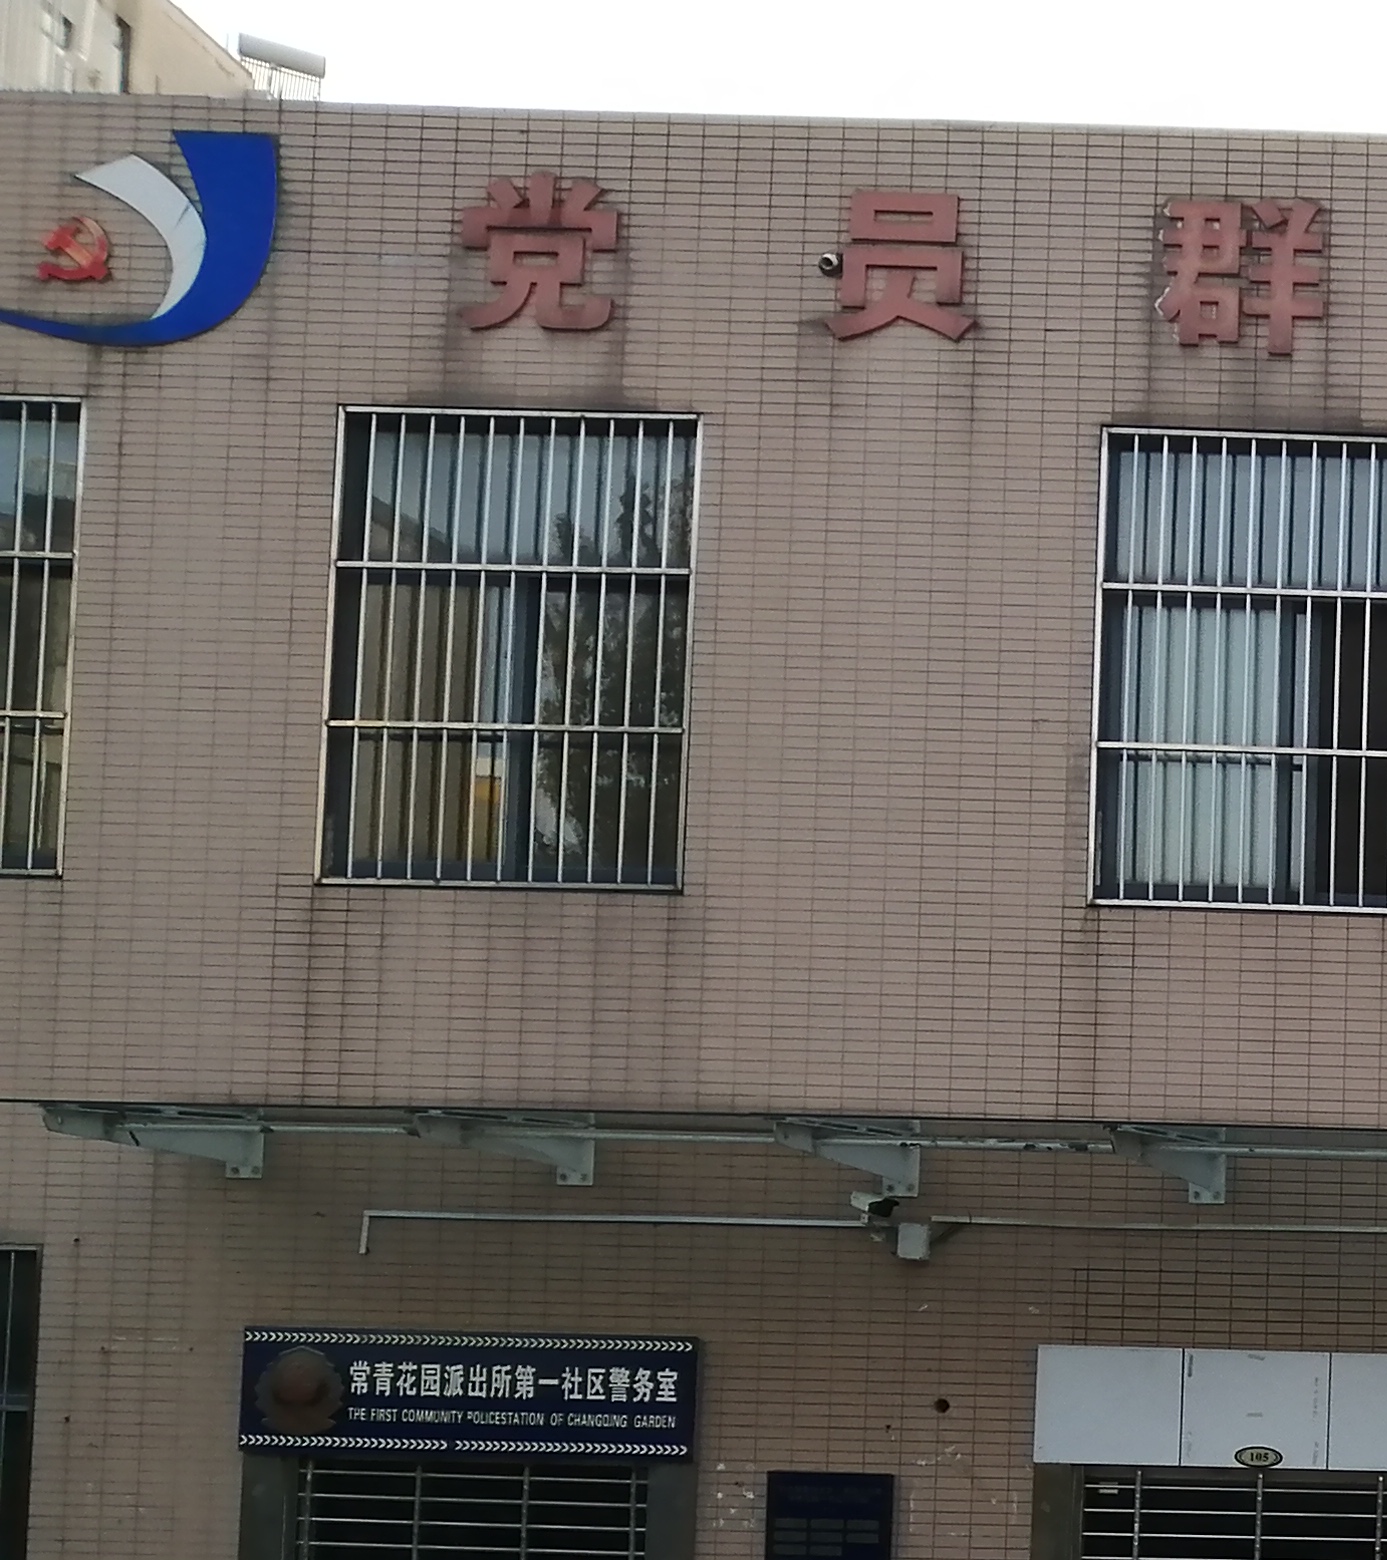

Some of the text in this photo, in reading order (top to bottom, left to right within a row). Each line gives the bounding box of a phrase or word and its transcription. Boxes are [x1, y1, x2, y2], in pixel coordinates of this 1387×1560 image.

[349, 1360, 680, 1403] 常青花园派出所第一社区警务室
[370, 1408, 398, 1422] FIRST
[401, 1408, 464, 1424] COMMUNITY
[550, 1412, 563, 1426] OF
[633, 1414, 677, 1429] GARDEN
[1250, 1453, 1269, 1462] 105
